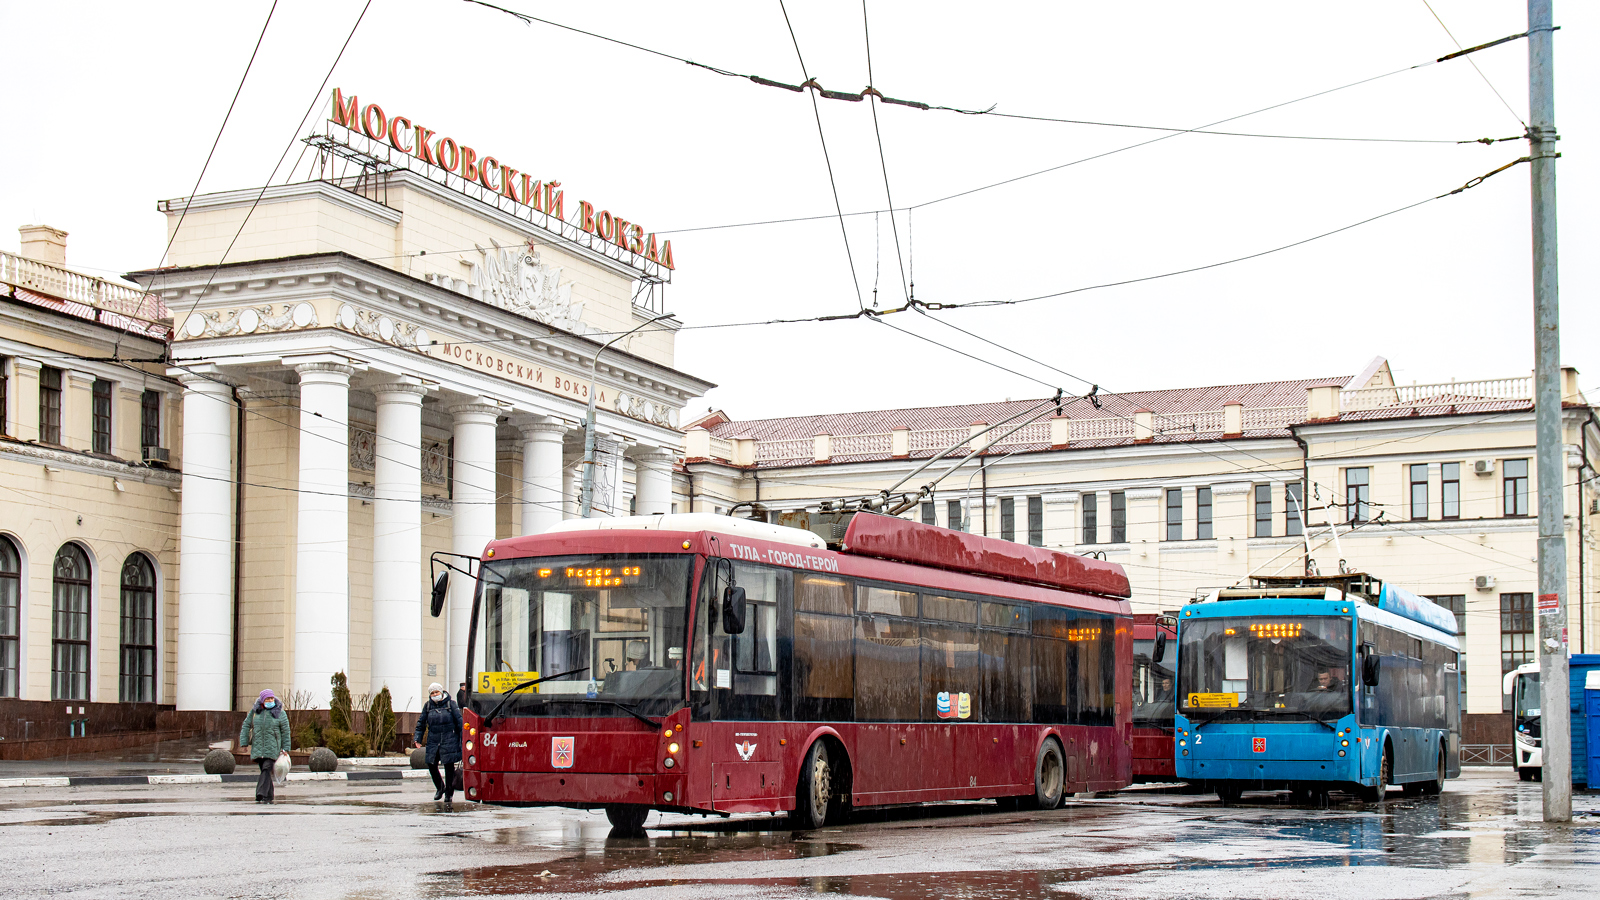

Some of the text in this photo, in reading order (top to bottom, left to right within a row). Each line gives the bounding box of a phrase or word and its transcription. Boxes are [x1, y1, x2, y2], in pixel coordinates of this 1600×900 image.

[331, 87, 675, 270] МОСКОВСКИЙ ВОКЗАЛ
[443, 342, 543, 383] МОСКОВСКИЙ
[729, 543, 760, 561] ТУЛА
[767, 549, 839, 572] ГОРОД-ГЕРОЙ
[482, 675, 490, 689] 5
[1191, 695, 1199, 706] 6
[483, 733, 498, 747] 84
[1195, 734, 1202, 745] 2
[970, 775, 977, 787] 84
